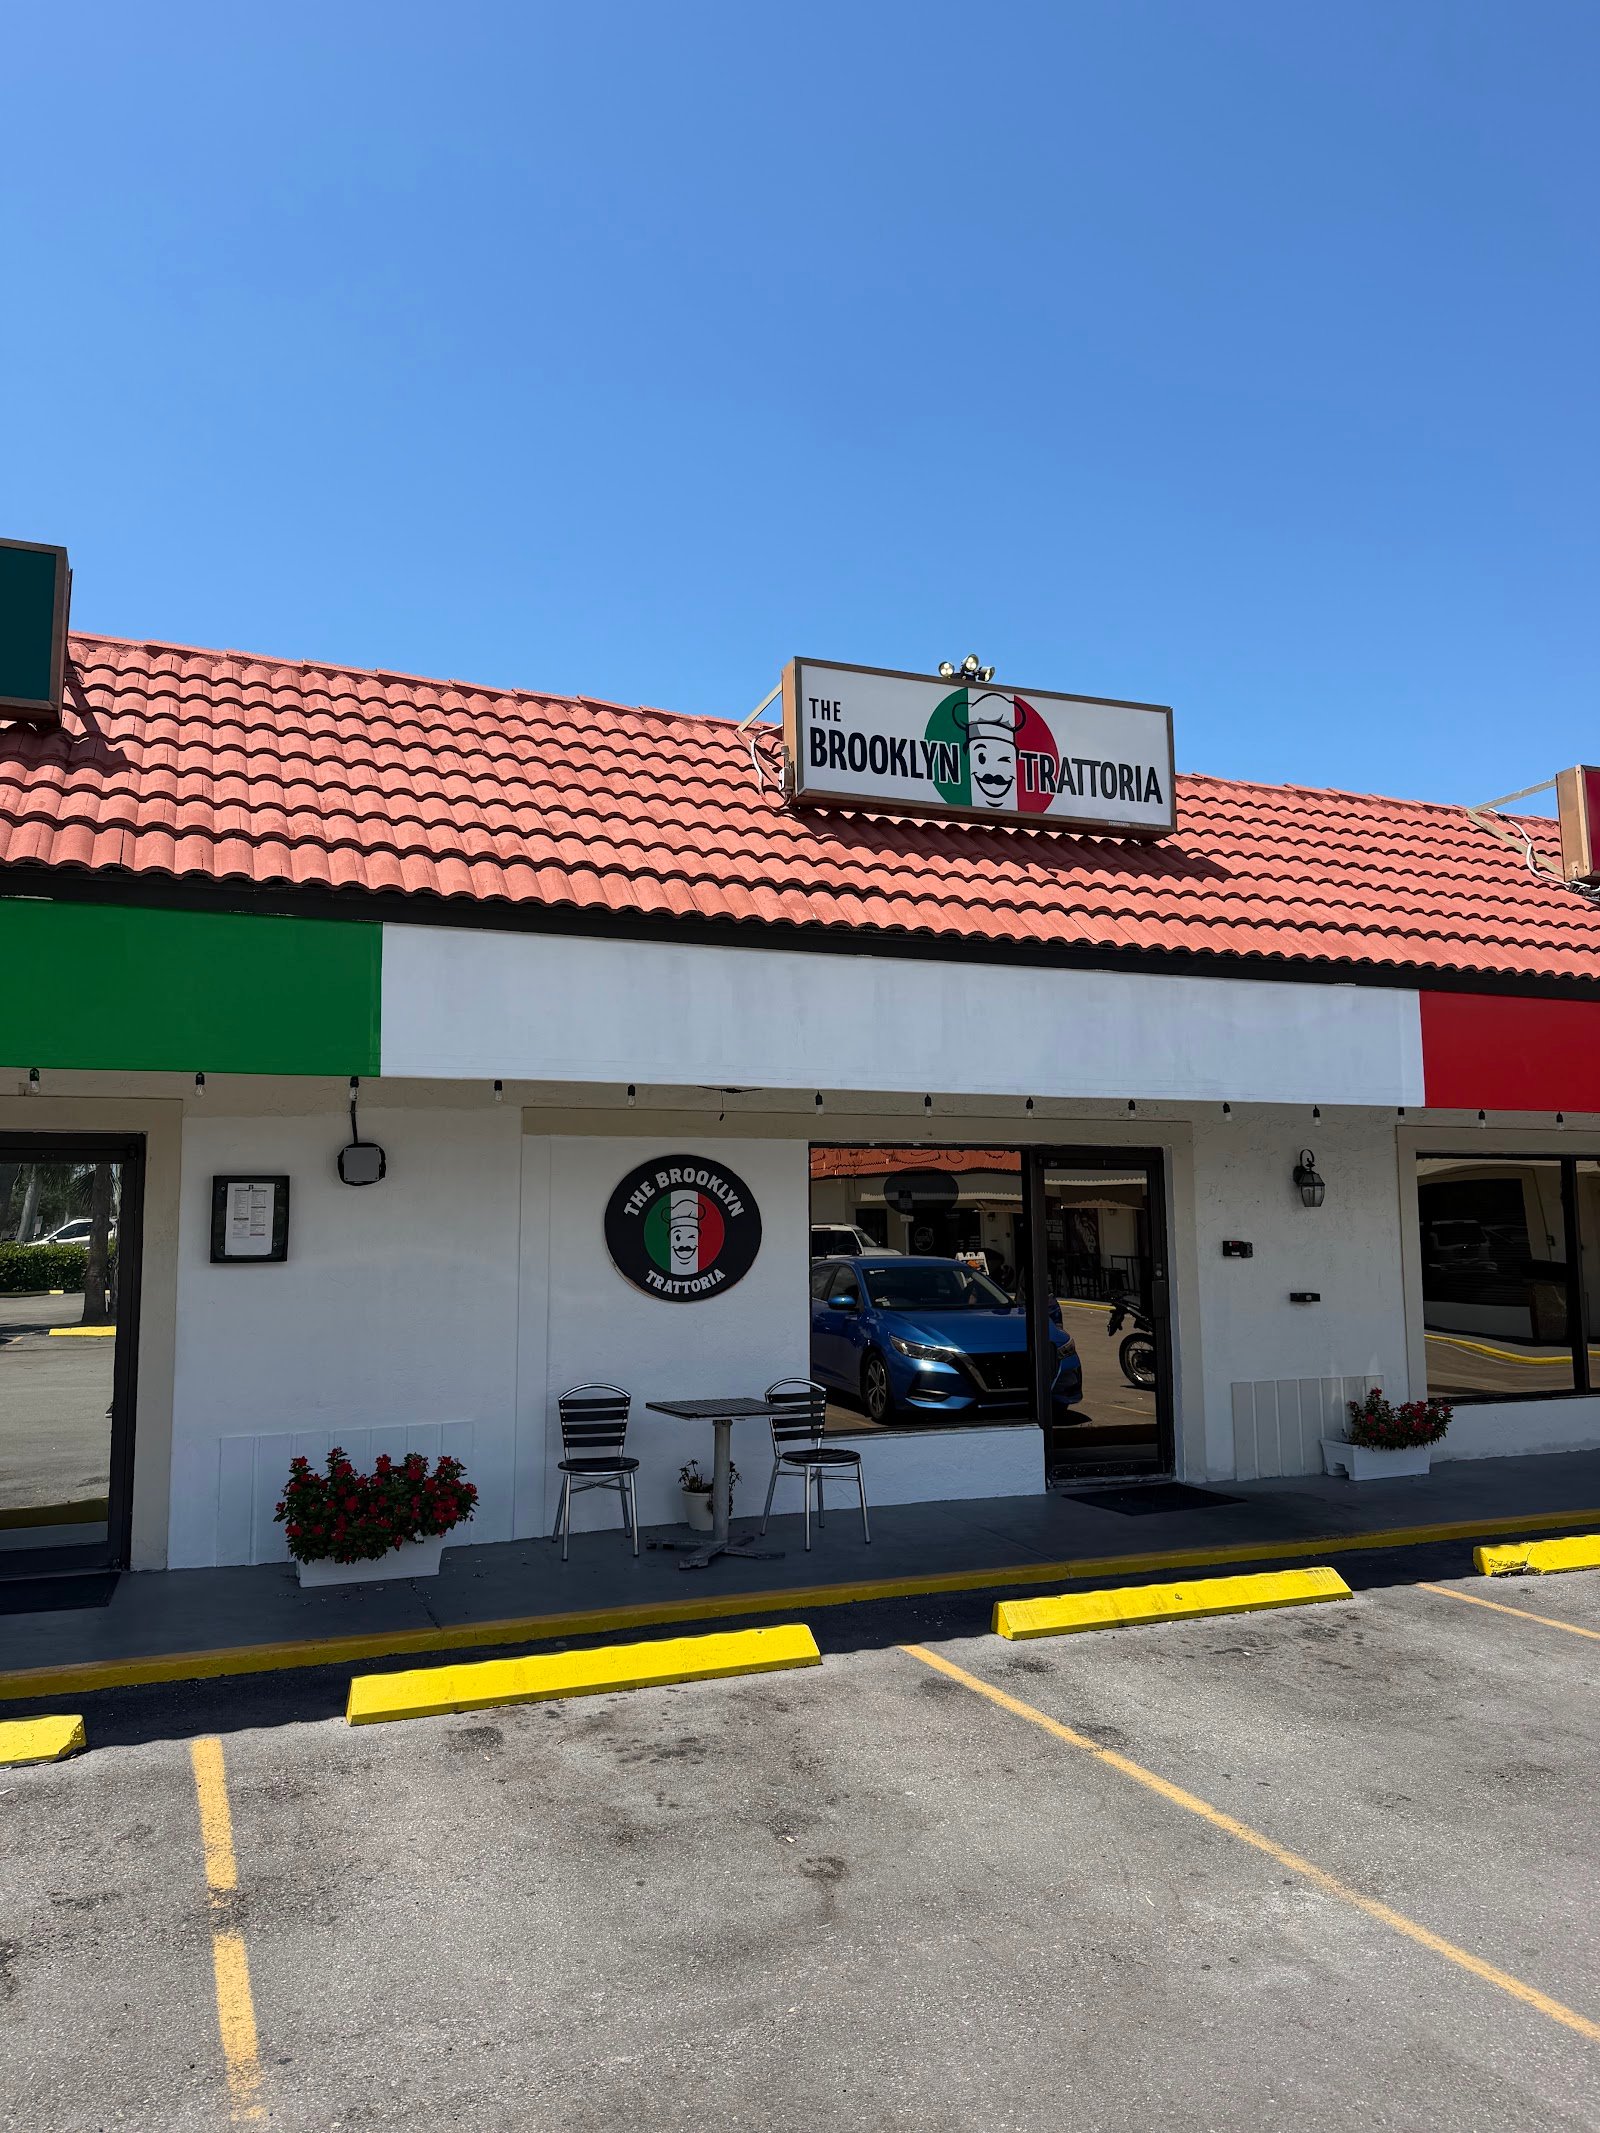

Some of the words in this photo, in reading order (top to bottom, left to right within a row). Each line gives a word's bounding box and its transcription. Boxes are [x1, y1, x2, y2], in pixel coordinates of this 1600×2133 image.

[808, 697, 842, 723] THE
[809, 726, 960, 784] BROOKLYN
[1020, 751, 1163, 804] TRATTORIA
[623, 1181, 656, 1216] THE
[655, 1167, 745, 1218] BROOKLYN
[645, 1268, 726, 1294] TRATTORIA
